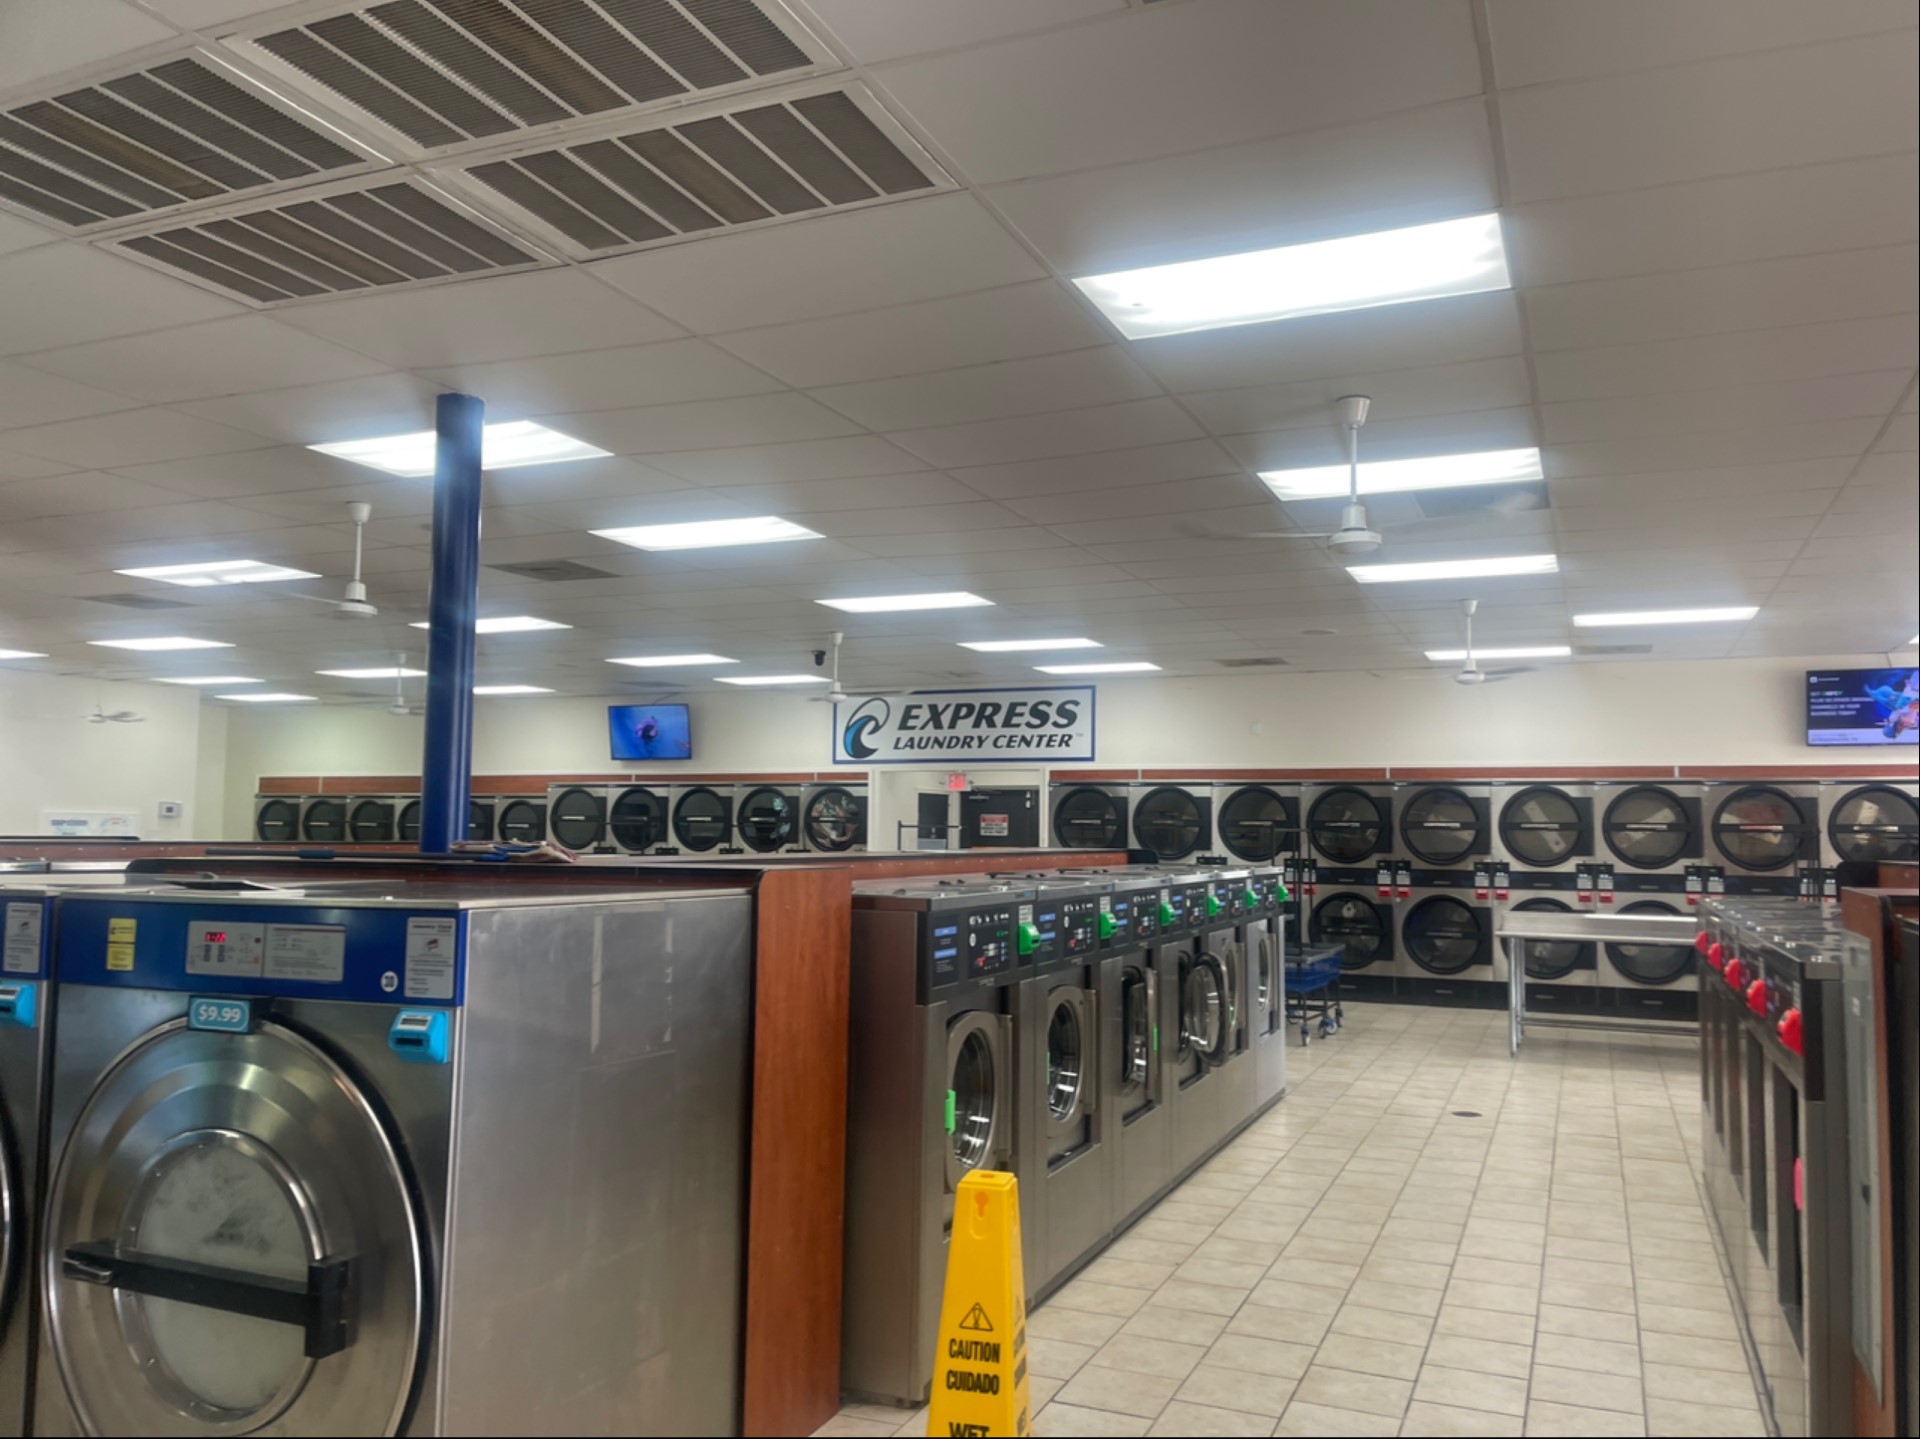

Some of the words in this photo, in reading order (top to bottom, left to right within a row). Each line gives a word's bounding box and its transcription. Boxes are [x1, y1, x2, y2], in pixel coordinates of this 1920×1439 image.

[898, 699, 1081, 731] EXPRESS
[893, 735, 990, 750] LAUNDRY
[993, 733, 1074, 749] CENTER
[198, 1005, 242, 1023] $9.99
[949, 1338, 1000, 1363] CAUTION
[946, 1370, 999, 1395] CUIDADO
[948, 1421, 990, 1437] WET
